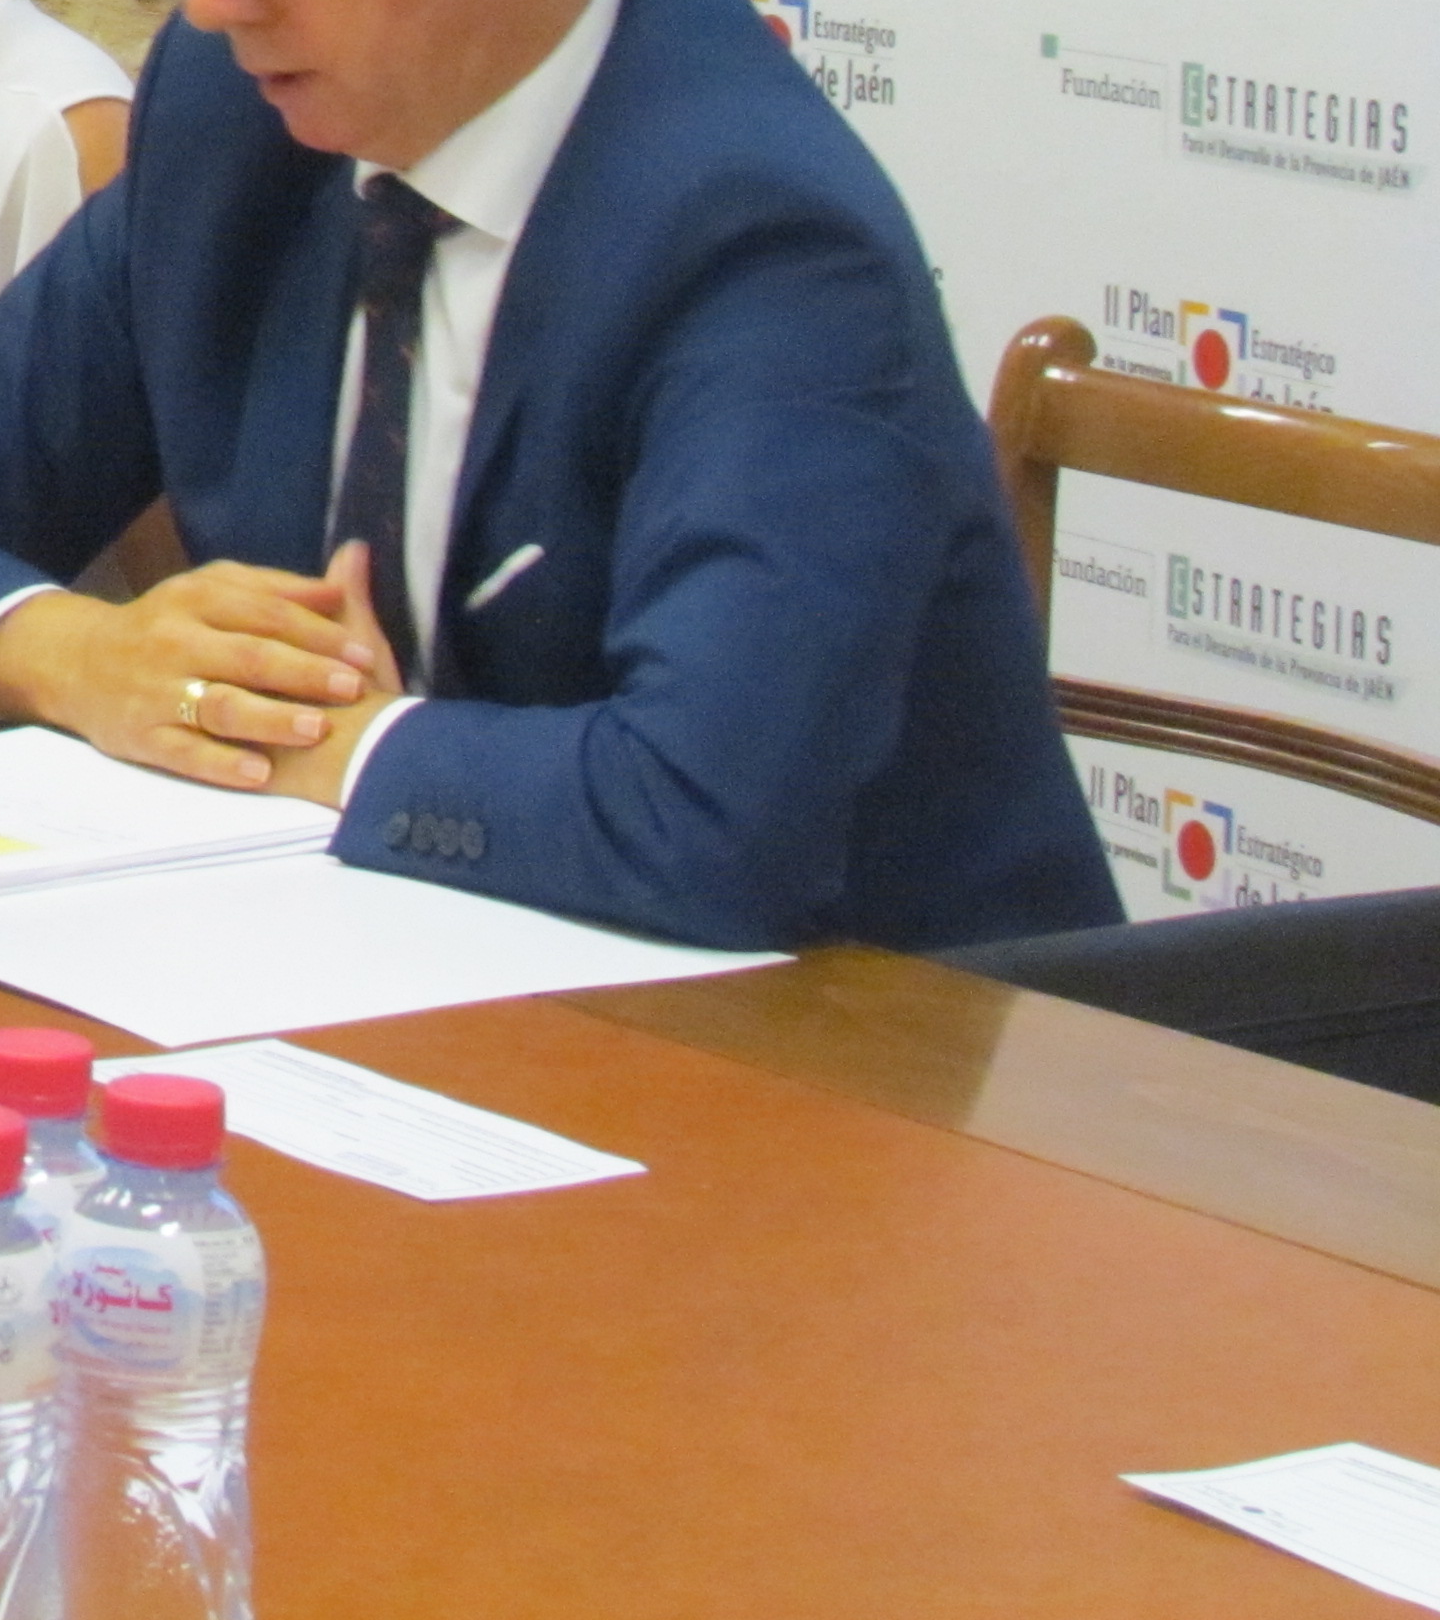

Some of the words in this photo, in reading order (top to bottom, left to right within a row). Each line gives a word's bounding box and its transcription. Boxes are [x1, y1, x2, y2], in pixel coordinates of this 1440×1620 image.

[842, 58, 895, 111] Jaén
[1060, 67, 1162, 111] Fundación
[1185, 67, 1408, 154] ESTRATEGIAS
[1128, 289, 1175, 341] Plan
[1173, 556, 1393, 666] ESTRATEGIAS
[1113, 770, 1160, 827] Plan
